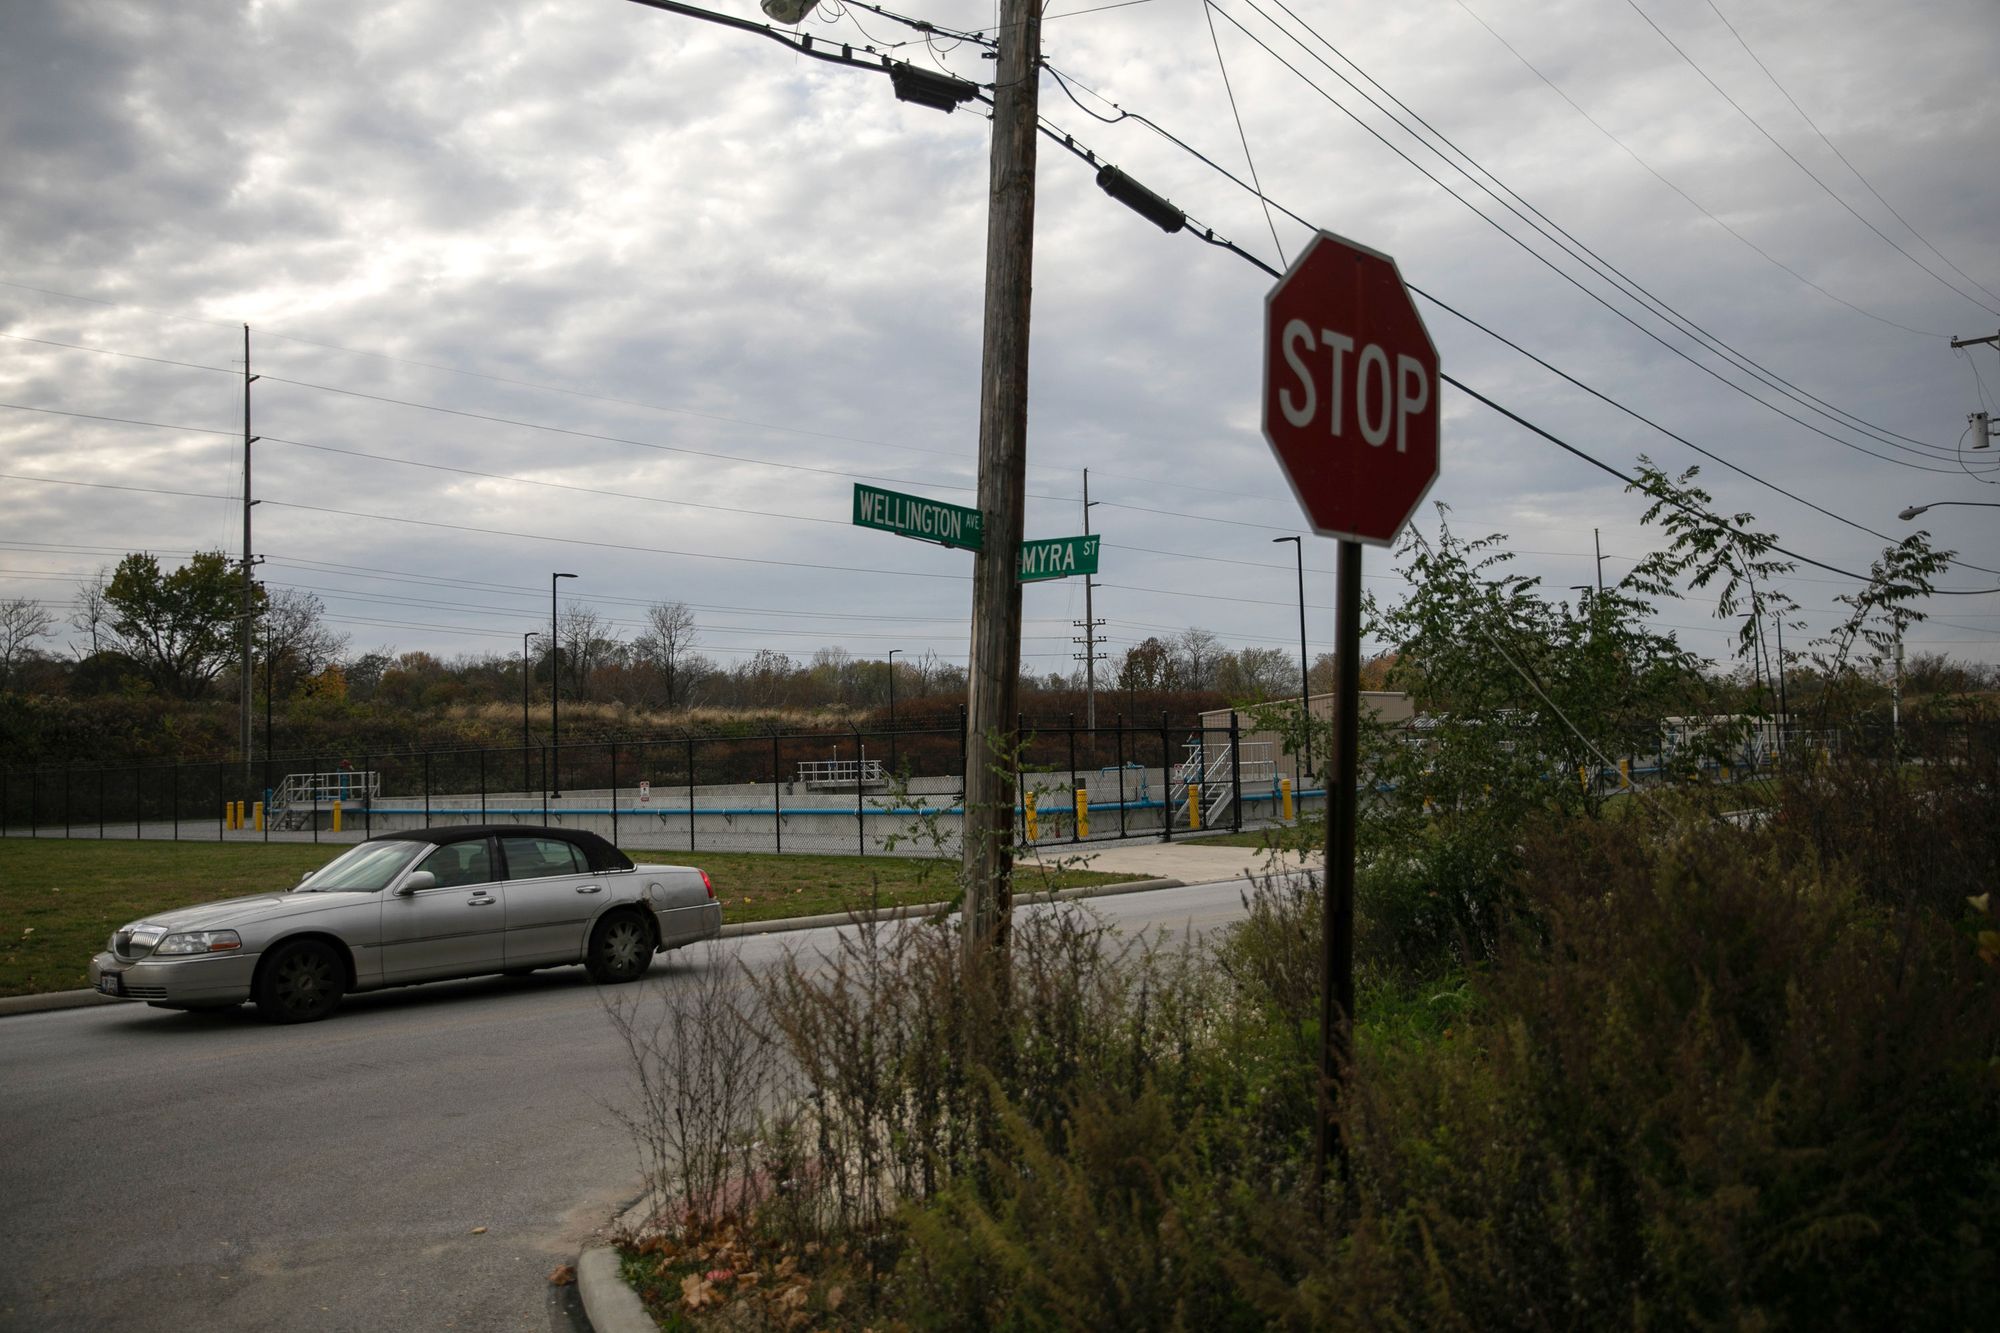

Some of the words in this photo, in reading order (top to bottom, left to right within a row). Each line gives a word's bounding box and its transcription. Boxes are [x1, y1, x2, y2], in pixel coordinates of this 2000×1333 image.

[1279, 318, 1429, 453] STOP
[859, 490, 961, 539] WELLINGTON
[965, 513, 980, 530] AVE
[1022, 543, 1075, 574] MYRA
[1083, 540, 1097, 556] ST
